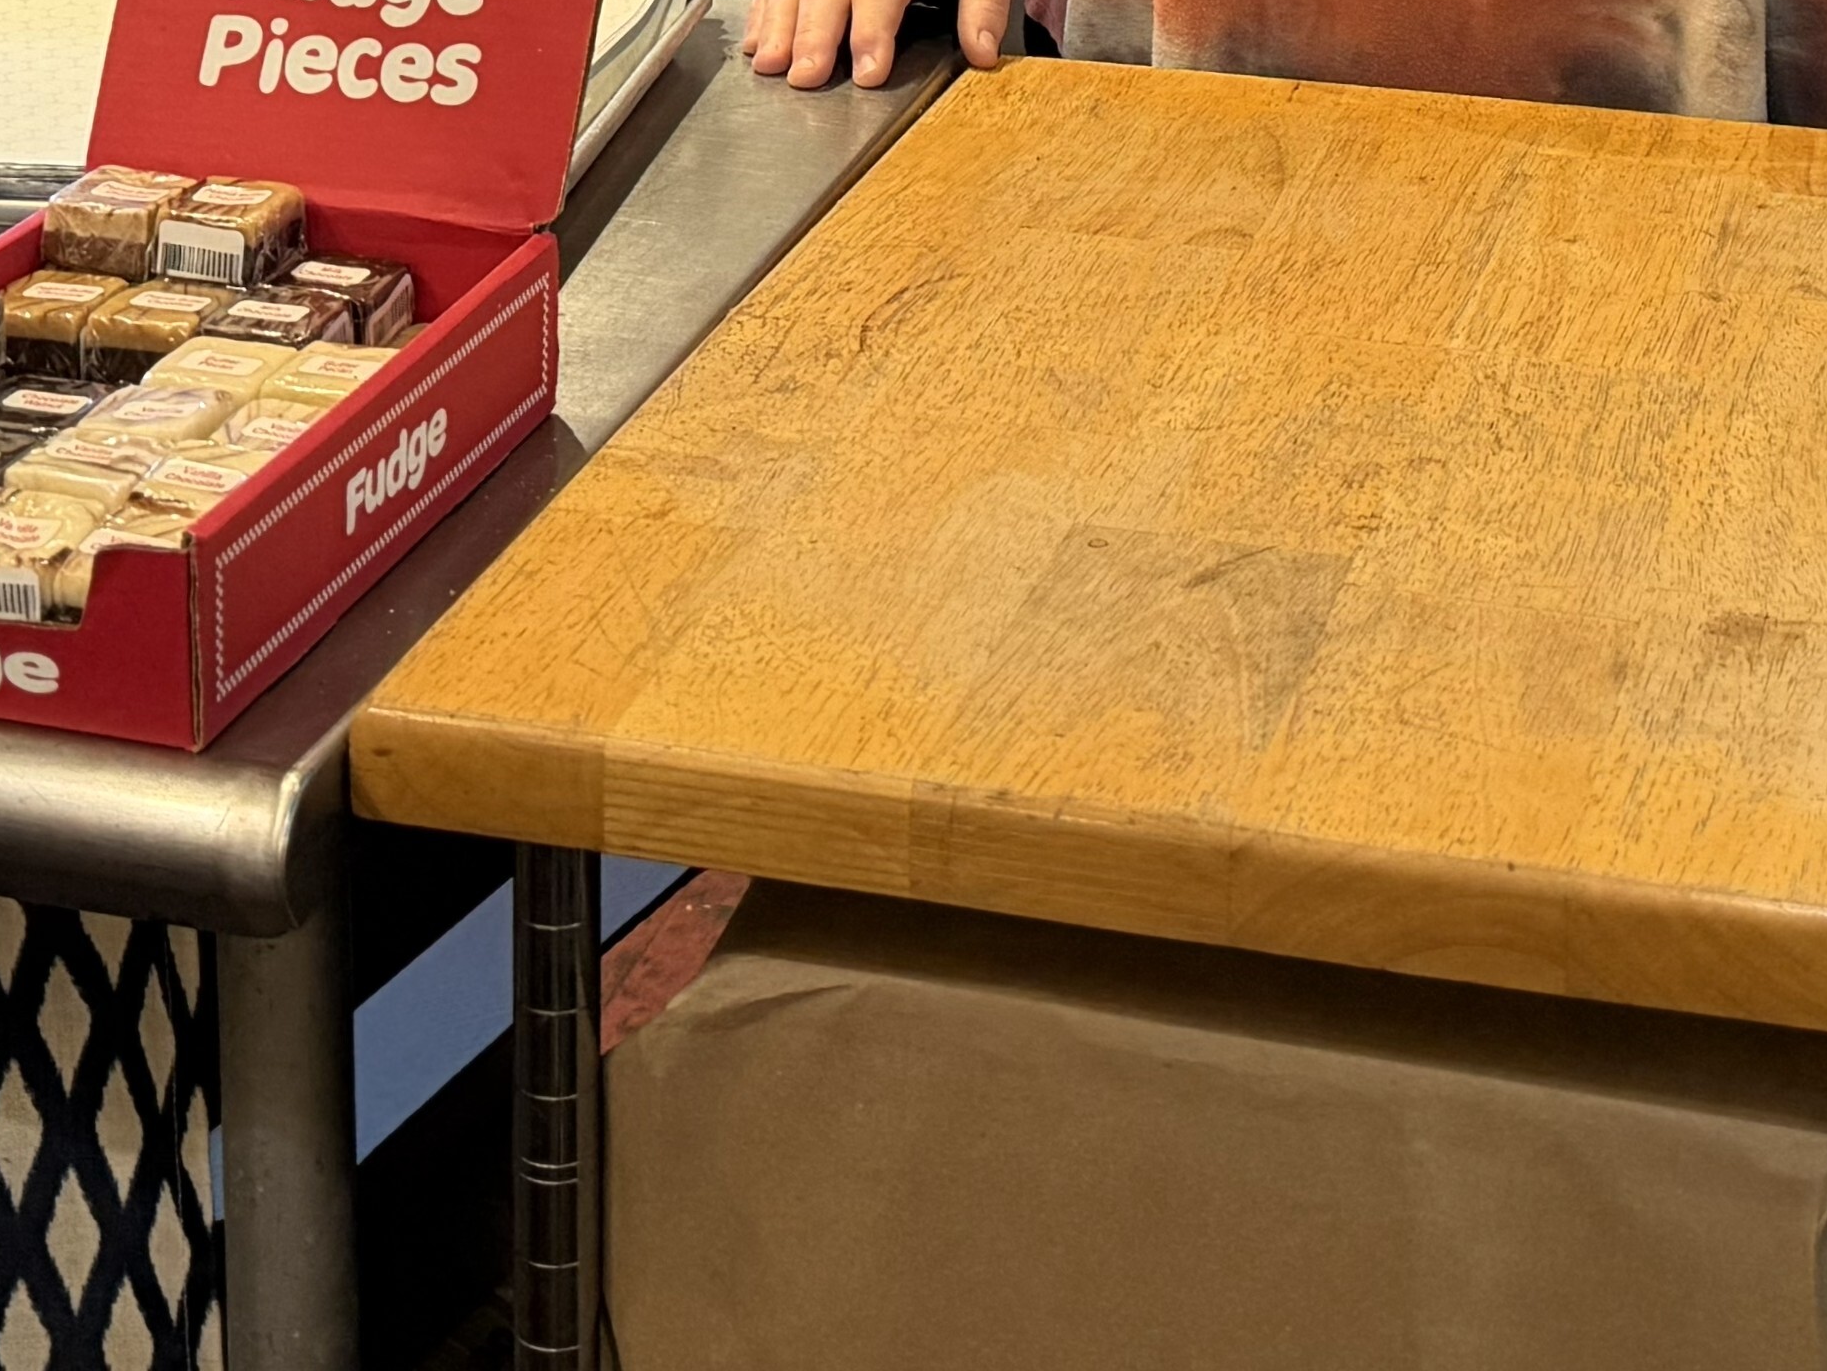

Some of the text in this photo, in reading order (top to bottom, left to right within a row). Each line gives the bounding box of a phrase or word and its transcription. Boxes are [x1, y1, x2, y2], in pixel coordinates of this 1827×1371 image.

[198, 12, 483, 107] Pieces
[164, 471, 225, 491] Chocolate
[182, 464, 223, 481] Vanilla
[346, 407, 448, 537] Fudge
